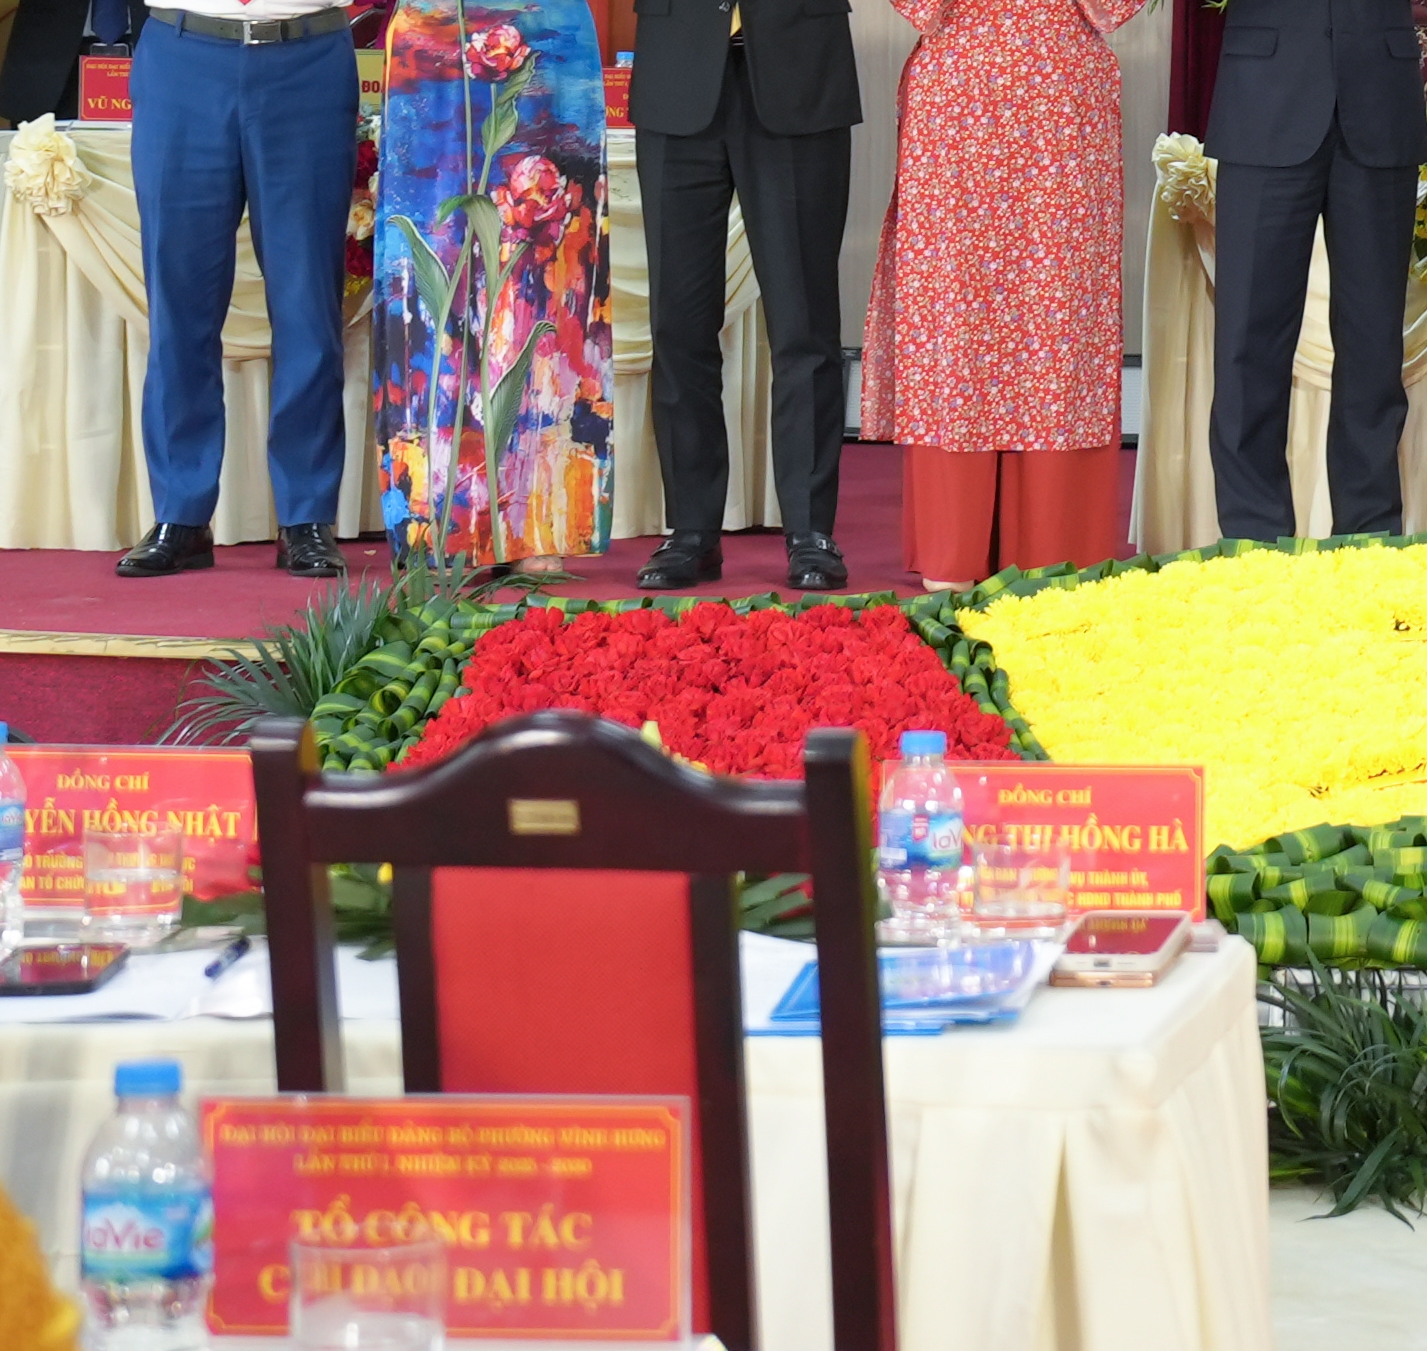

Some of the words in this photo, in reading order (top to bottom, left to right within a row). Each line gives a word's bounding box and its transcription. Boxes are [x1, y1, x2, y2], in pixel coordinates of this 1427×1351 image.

[110, 97, 133, 111] NG
[56, 767, 111, 790] ĐỒNG
[114, 771, 151, 791] CHÍ
[997, 783, 1053, 805] ĐỒNG
[1056, 786, 1092, 805] CHÍ
[24, 797, 77, 835] YỄN
[82, 797, 159, 838] HỒNG
[166, 804, 242, 847] NHẬT
[1060, 812, 1143, 853] HỒNG
[1148, 817, 1190, 853] HÀ
[499, 1201, 594, 1250] TÁC
